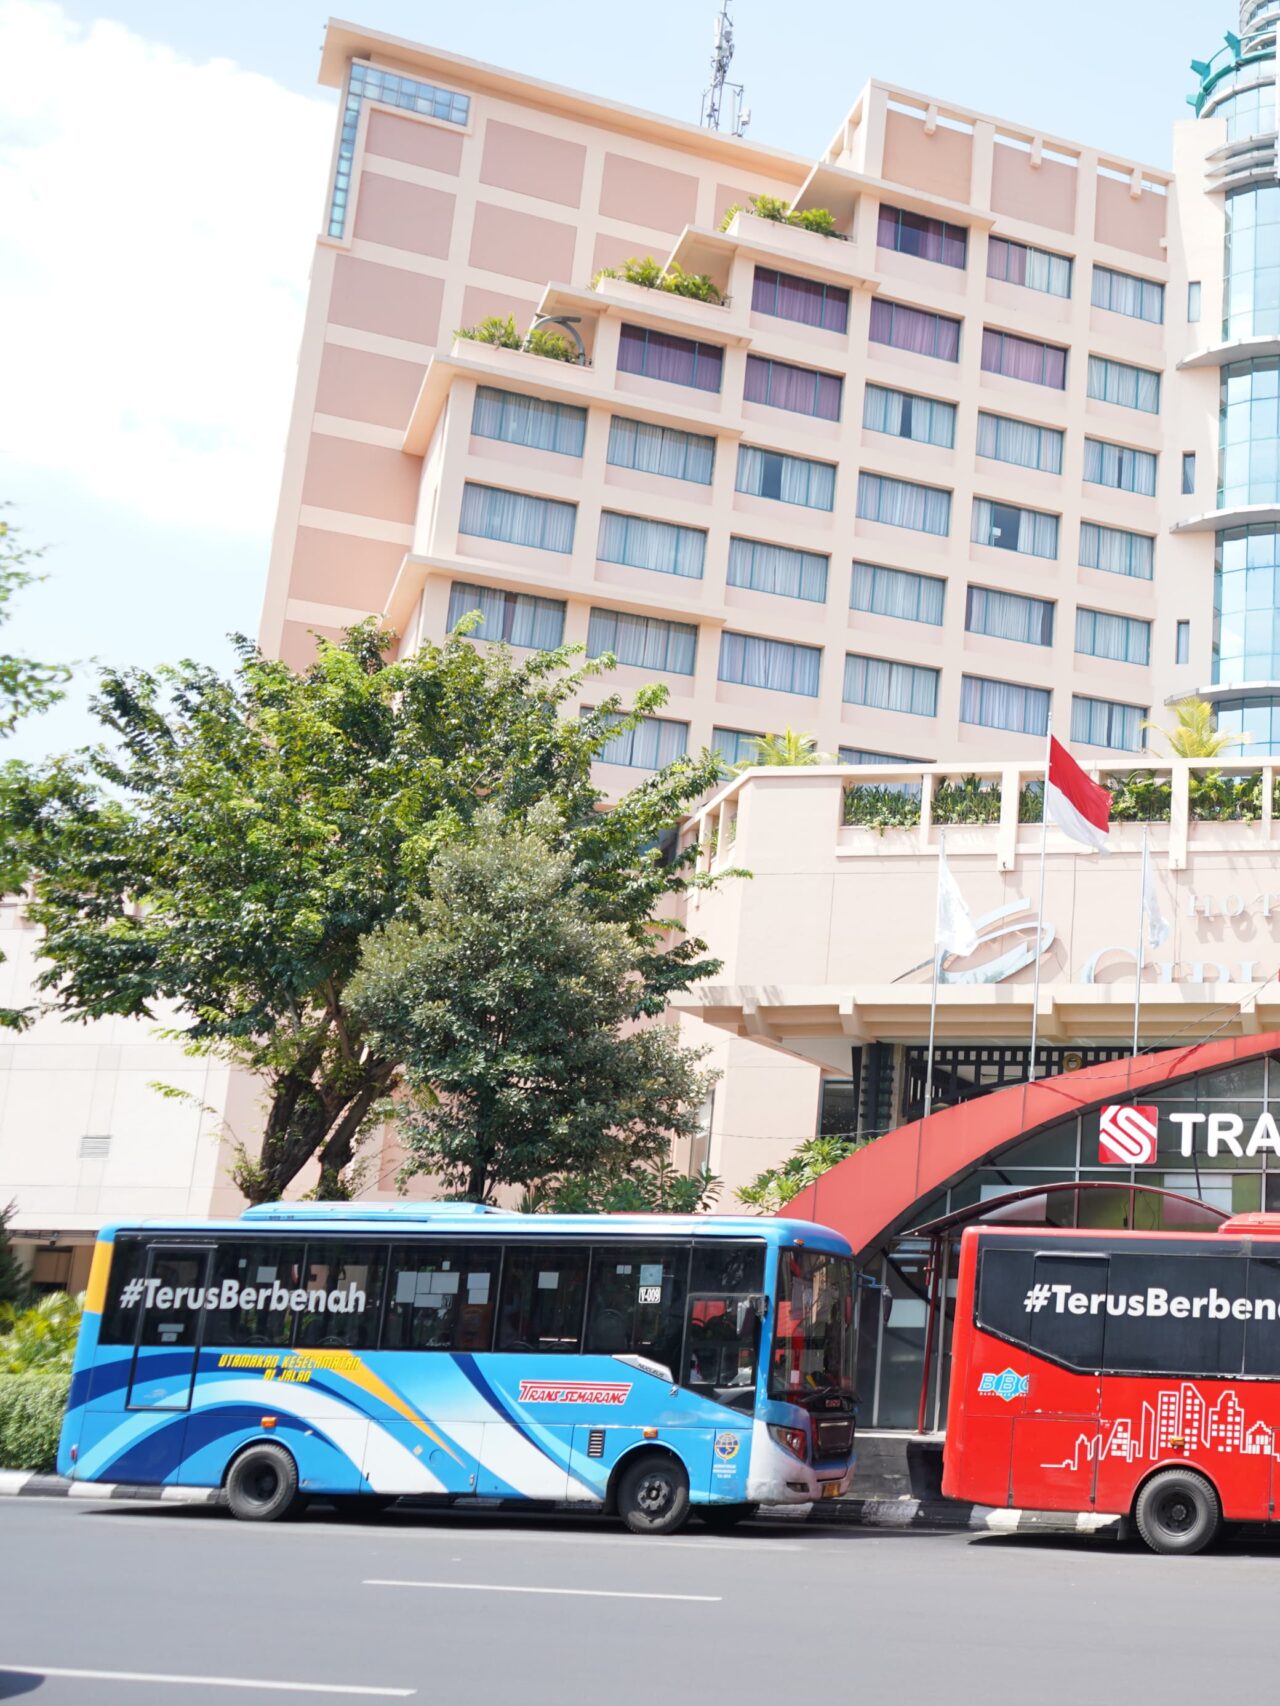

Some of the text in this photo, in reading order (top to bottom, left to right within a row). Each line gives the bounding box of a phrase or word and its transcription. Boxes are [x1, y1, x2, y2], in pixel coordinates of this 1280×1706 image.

[120, 1278, 366, 1313] #TerusBerbenah
[519, 1384, 627, 1404] TRANS SEMARANG
